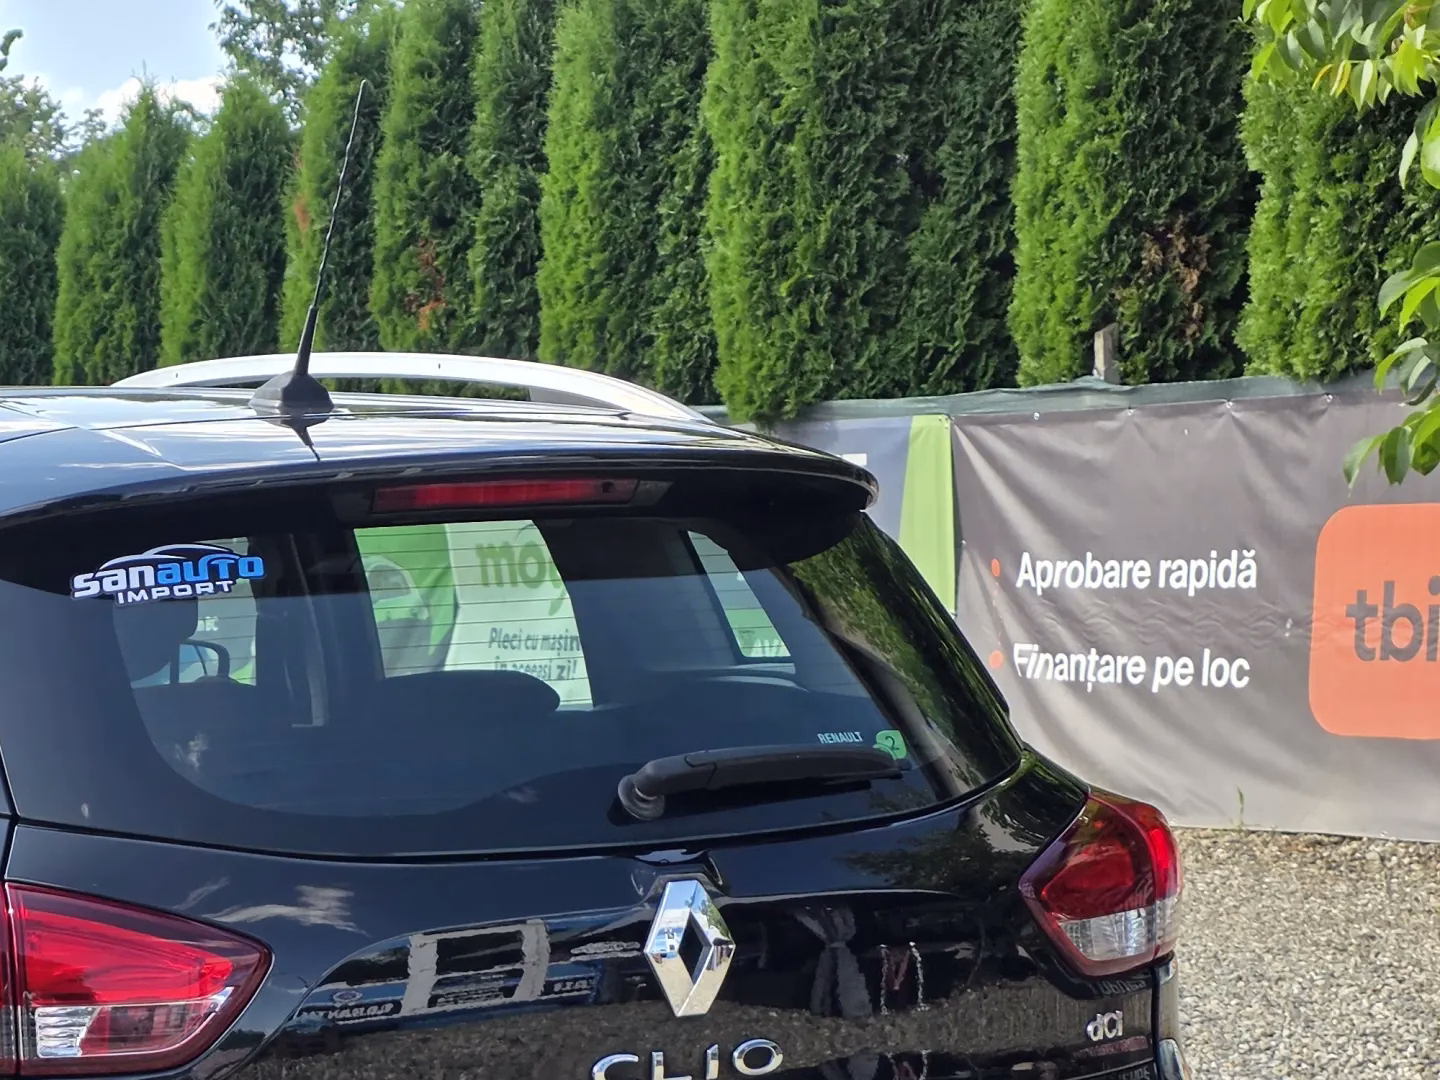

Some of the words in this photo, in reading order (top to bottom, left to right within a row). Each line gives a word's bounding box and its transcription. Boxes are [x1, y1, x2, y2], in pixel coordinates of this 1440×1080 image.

[1016, 551, 1152, 595] Aprobare
[1158, 549, 1257, 597] rapidă
[118, 580, 234, 604] IMPORT
[1345, 575, 1440, 663] tbi
[488, 627, 523, 651] Pleci
[524, 634, 539, 651] cu
[556, 659, 578, 681] zi!
[1013, 643, 1146, 692] Finanțare
[1151, 654, 1194, 693] pe
[1201, 648, 1251, 688] loc
[817, 731, 864, 744] RENAULT
[885, 735, 900, 751] 2
